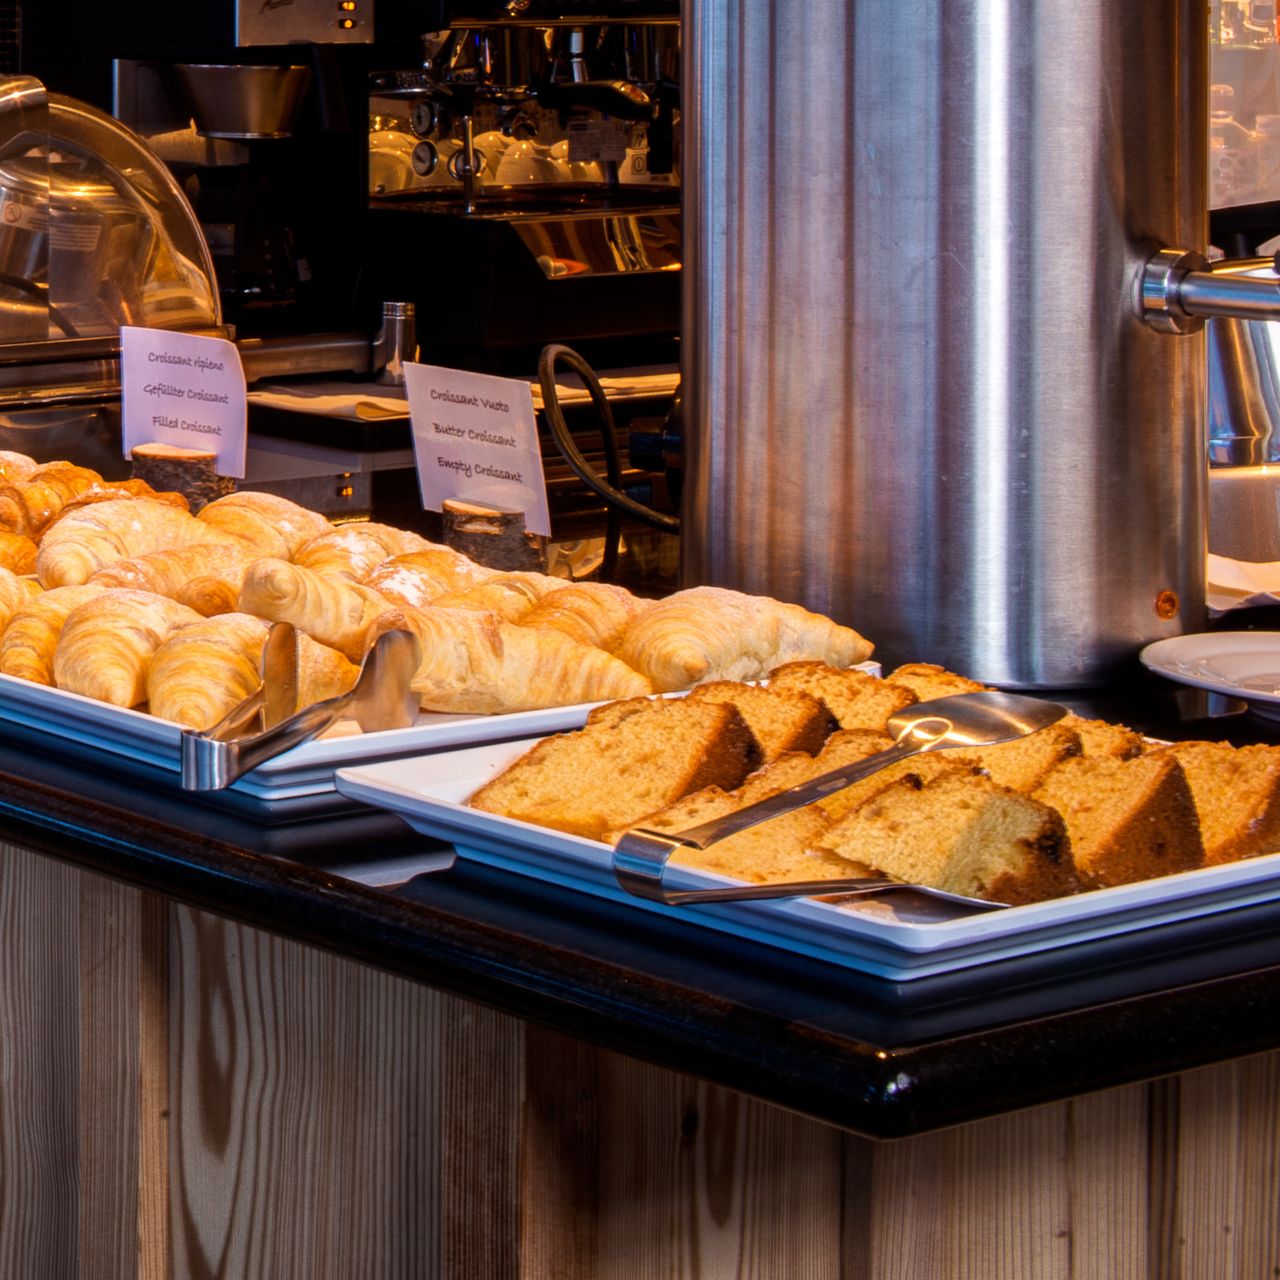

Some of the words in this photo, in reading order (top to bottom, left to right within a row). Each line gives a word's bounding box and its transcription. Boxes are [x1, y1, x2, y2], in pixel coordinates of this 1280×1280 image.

[148, 352, 192, 367] Croissant
[194, 357, 224, 373] ripieno
[143, 382, 185, 398] Gefüllter
[187, 389, 230, 405] Croissant
[430, 389, 479, 407] Croissant
[480, 398, 510, 413] Vuoto
[152, 416, 179, 429] Filled
[180, 420, 222, 437] Croissant
[432, 422, 466, 438] Butter
[468, 429, 517, 448] Croissant
[438, 456, 472, 478] Empty
[474, 463, 523, 483] Croissant
